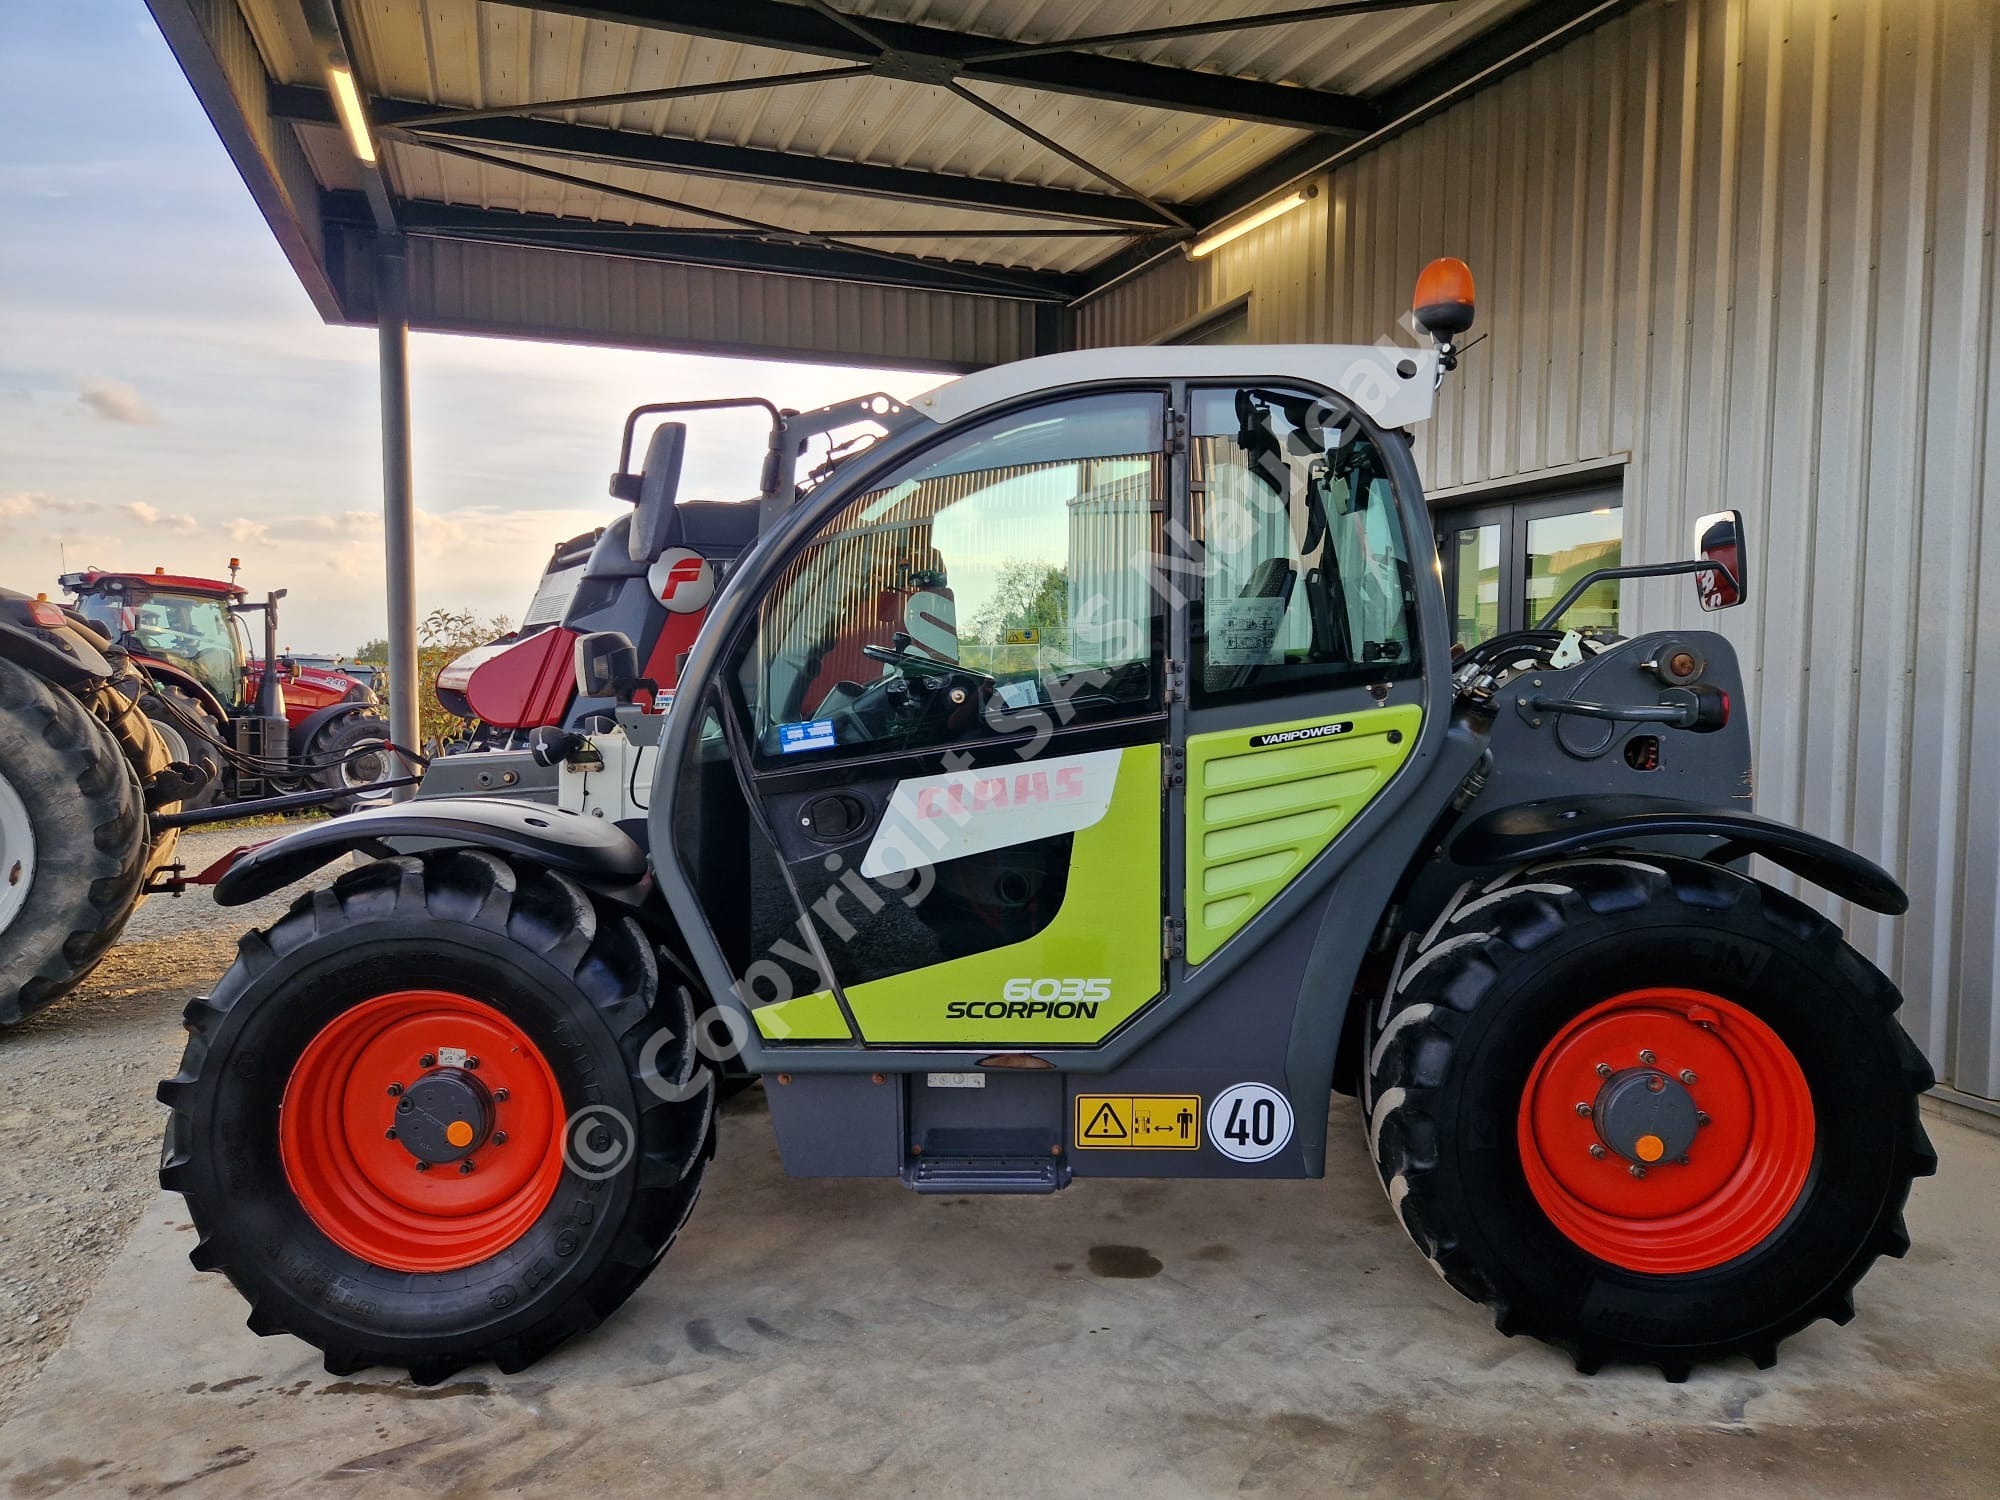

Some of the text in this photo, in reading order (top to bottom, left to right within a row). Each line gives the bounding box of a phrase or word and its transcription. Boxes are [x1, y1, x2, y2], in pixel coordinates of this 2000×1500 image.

[326, 677, 346, 687] 240
[1261, 724, 1342, 745] VARIPOWER
[917, 766, 1084, 819] CLAAS
[1003, 978, 1112, 1003] 6035
[945, 1002, 1099, 1019] SCORPION
[1224, 1098, 1275, 1146] 40
